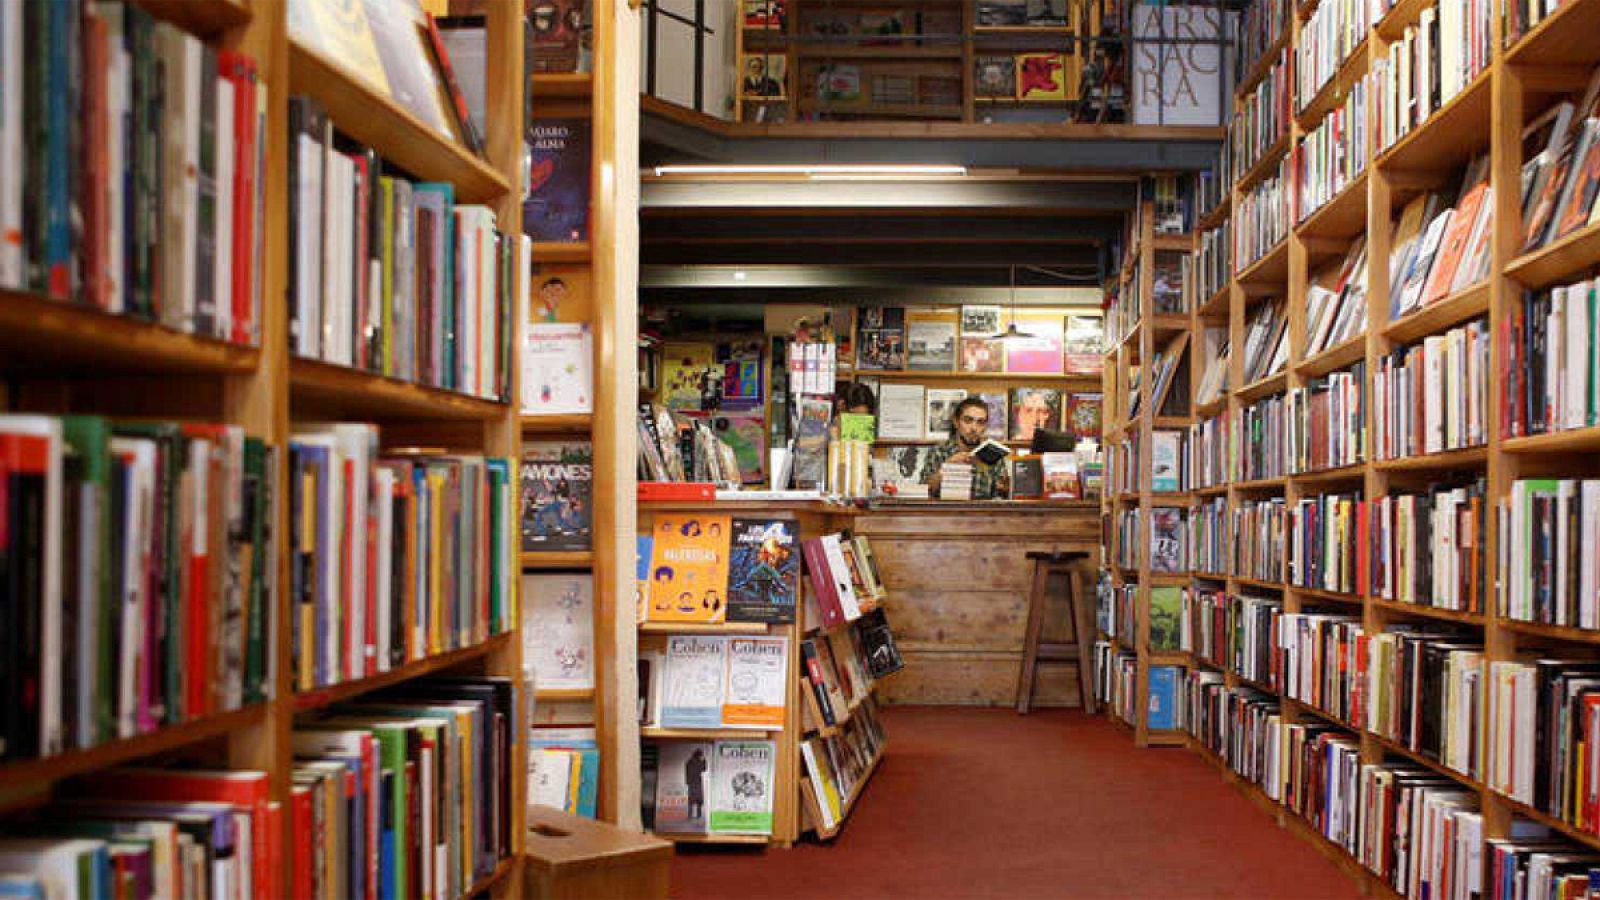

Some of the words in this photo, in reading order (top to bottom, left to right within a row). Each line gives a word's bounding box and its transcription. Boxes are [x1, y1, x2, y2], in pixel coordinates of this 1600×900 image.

[1143, 7, 1221, 41] ARS
[671, 638, 720, 654] Cohen
[731, 638, 782, 655] Cohen
[719, 743, 769, 759] Cohen
